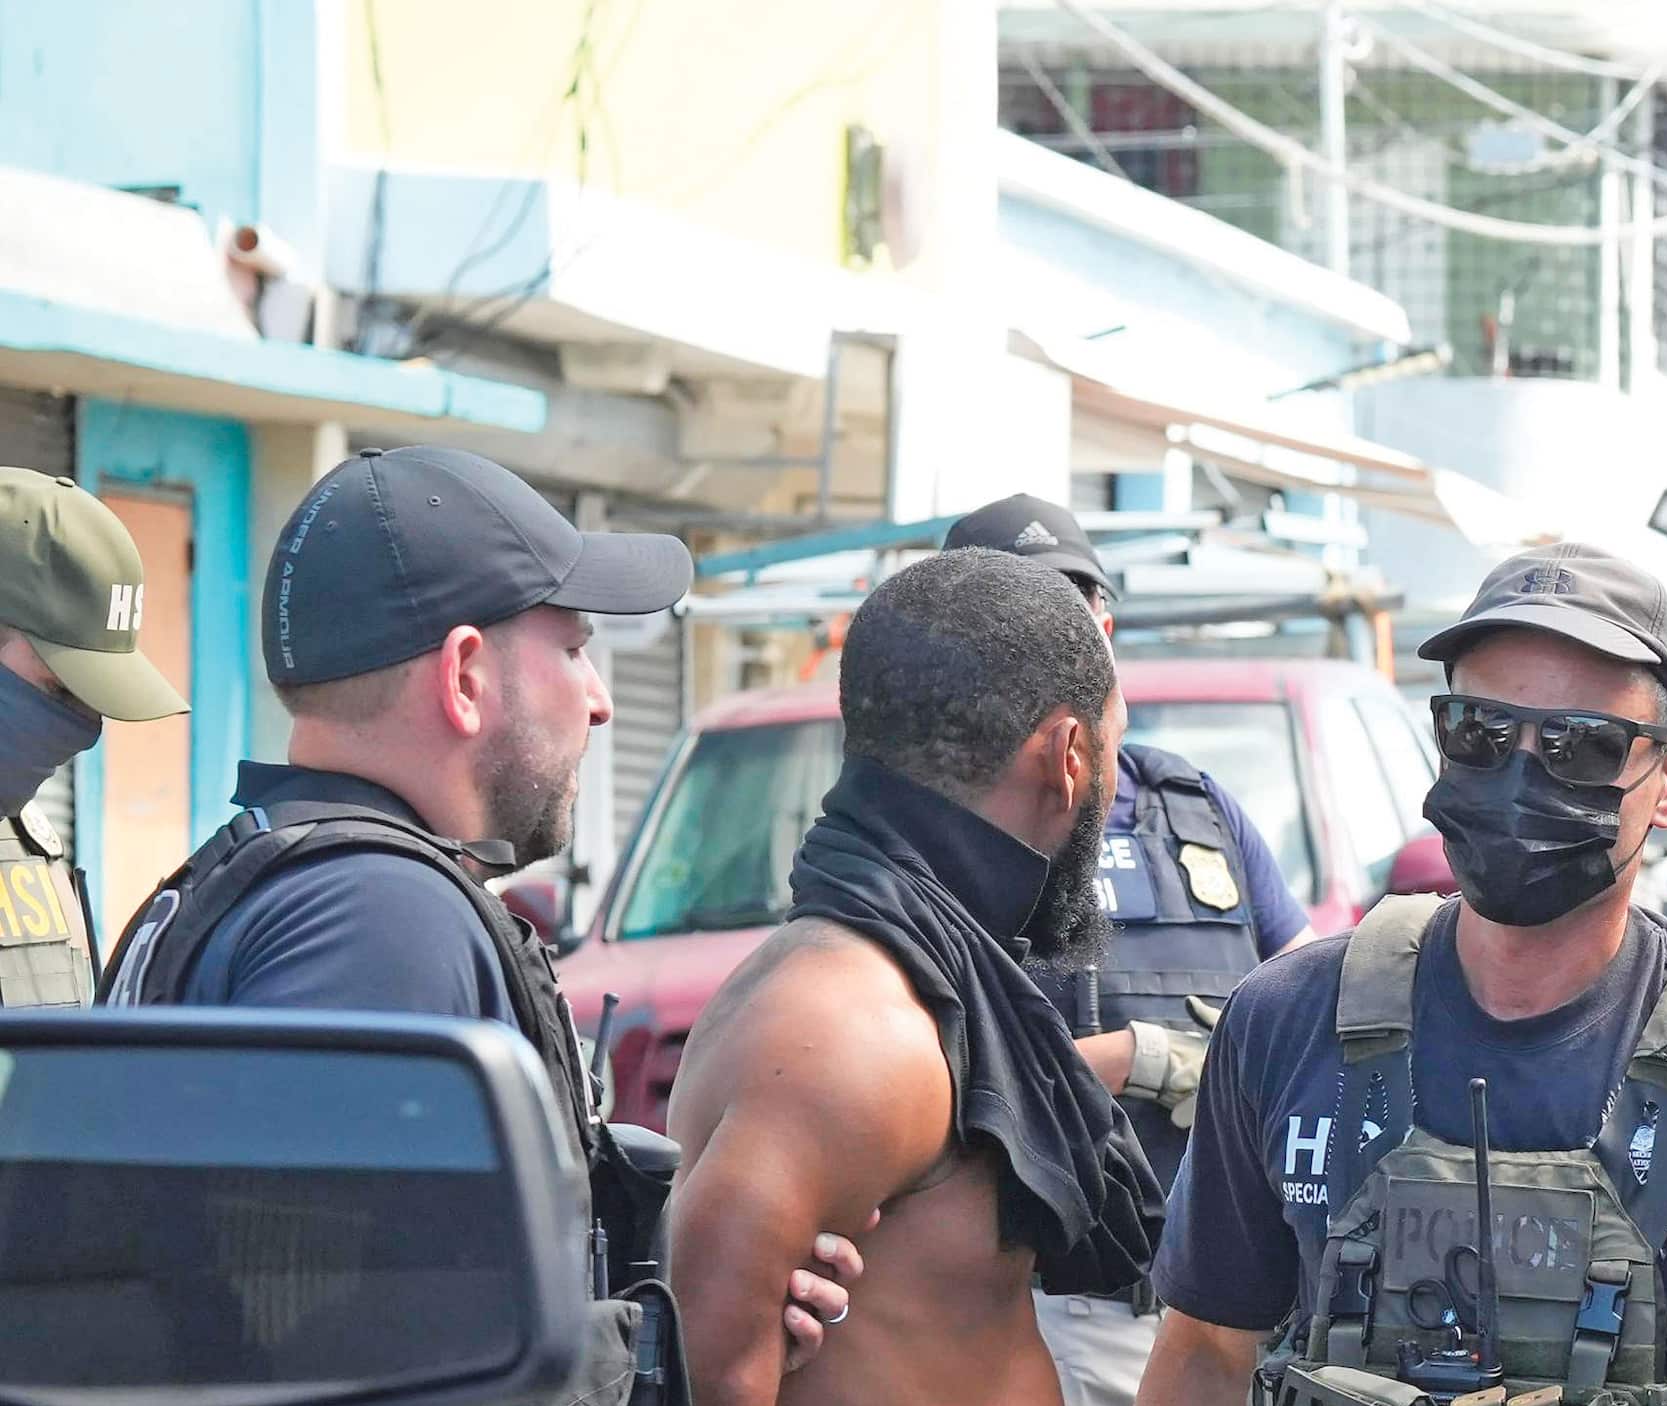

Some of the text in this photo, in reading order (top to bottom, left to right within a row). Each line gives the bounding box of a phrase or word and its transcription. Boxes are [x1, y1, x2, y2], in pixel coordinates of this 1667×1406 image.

[279, 481, 340, 669] UNDER ARMOUR
[106, 584, 144, 631] HS
[1282, 1181, 1329, 1205] SPECIA
